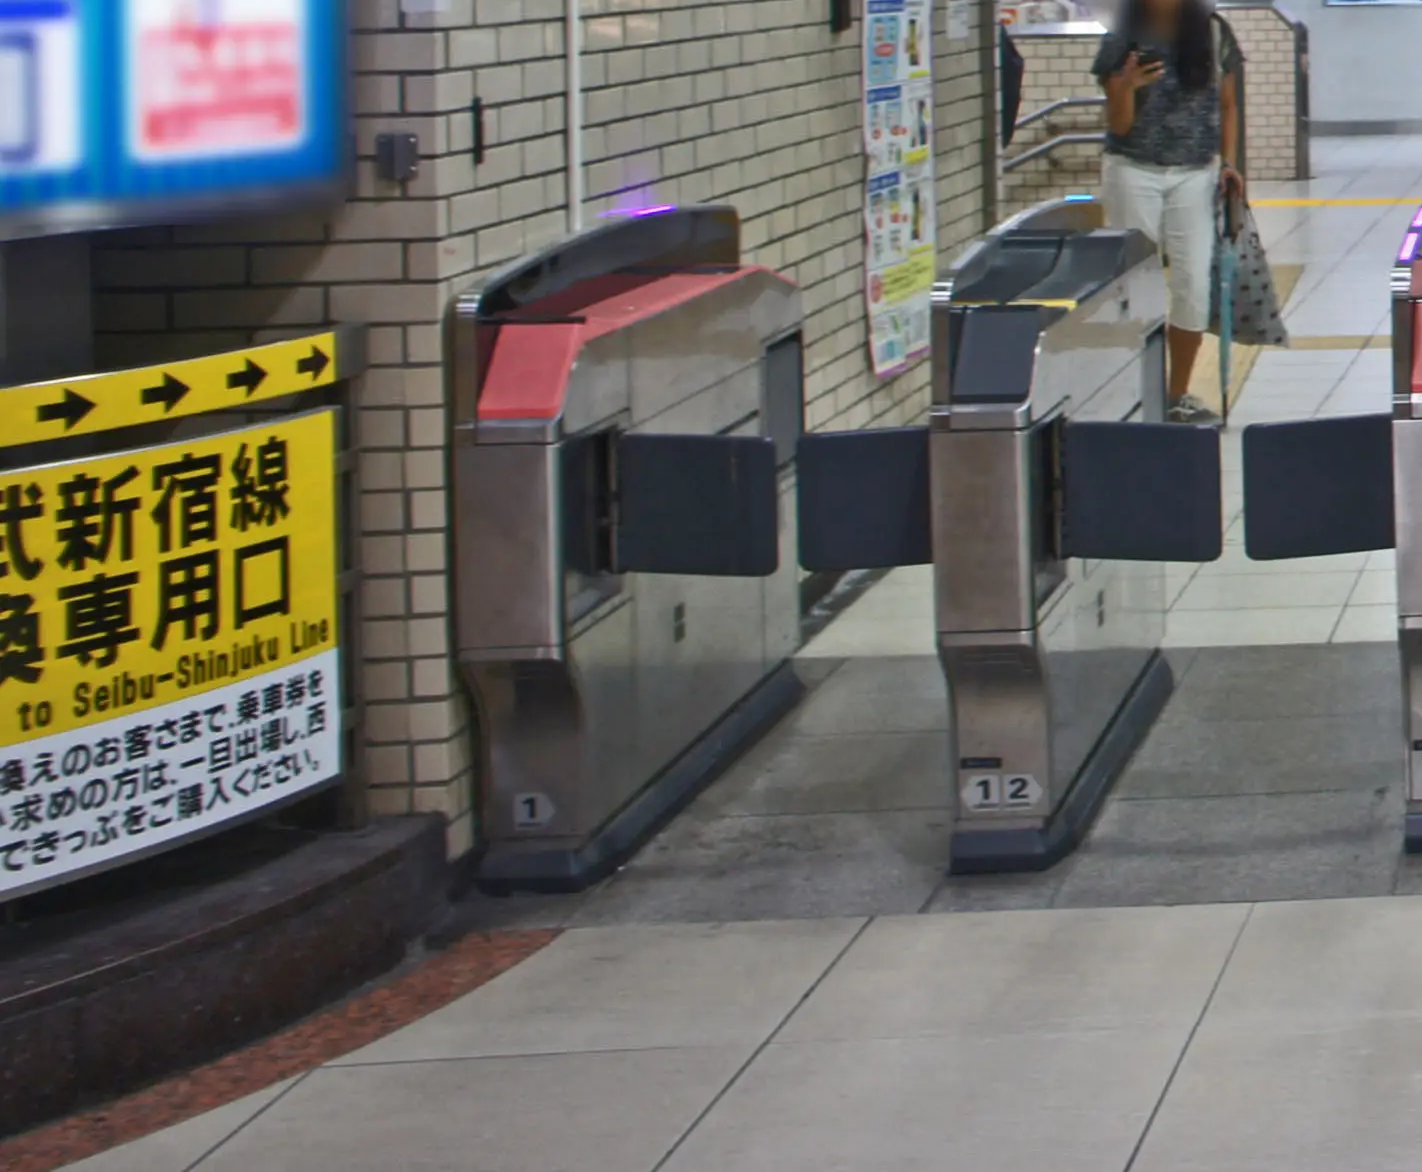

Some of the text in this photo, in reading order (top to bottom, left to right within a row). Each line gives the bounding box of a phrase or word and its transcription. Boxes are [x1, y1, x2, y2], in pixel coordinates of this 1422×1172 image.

[17, 614, 329, 734] to Seibu-Shinjuku Line
[0, 702, 327, 834] 求めの方は、一旦出場し、西
[975, 777, 1030, 802] 1 2
[521, 796, 537, 820] 1
